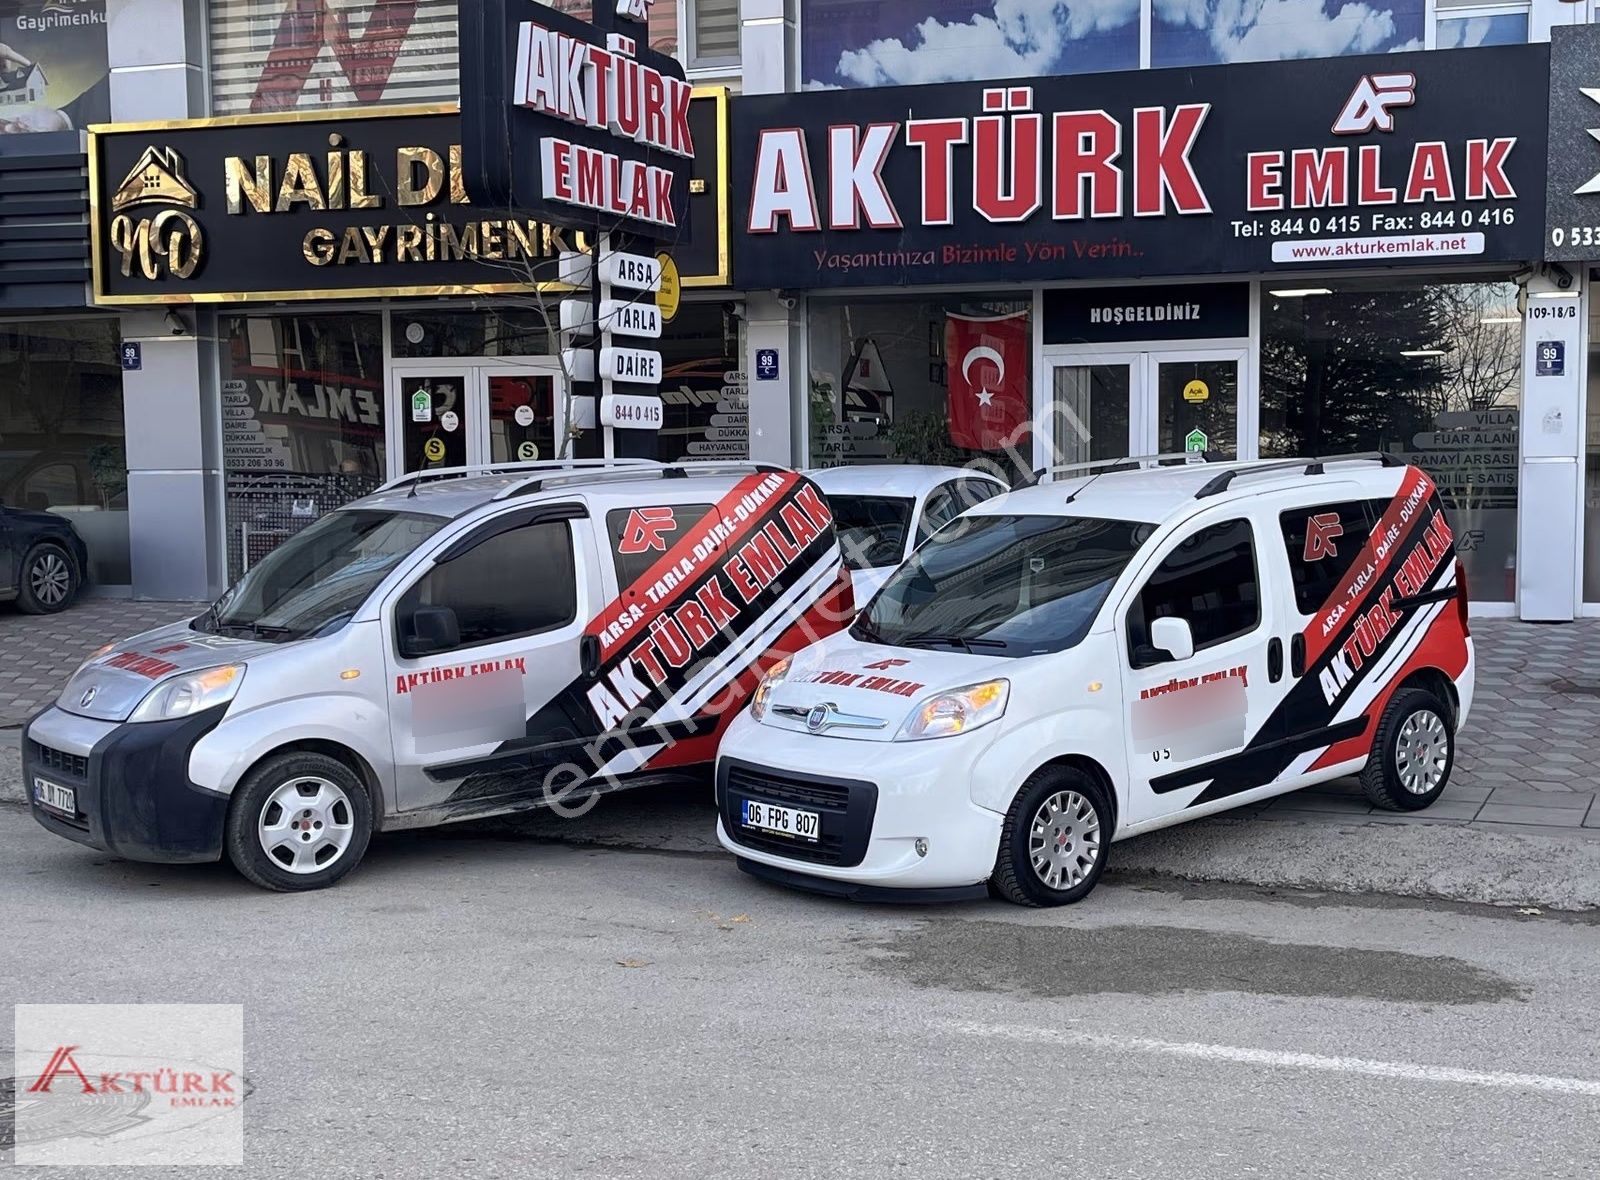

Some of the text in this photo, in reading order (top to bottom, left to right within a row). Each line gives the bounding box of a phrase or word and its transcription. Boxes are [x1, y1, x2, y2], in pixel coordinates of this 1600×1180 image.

[514, 21, 695, 159] AKTÜRK
[746, 86, 1214, 233] AKTÜRK
[224, 133, 382, 215] NAİL
[540, 136, 677, 227] EMLAK
[1246, 137, 1518, 212] EMLAK
[1231, 208, 1515, 237] Tel: 844 0 415 Fax: 844 0 416
[1291, 236, 1467, 258] www.akturkemlak.net
[1551, 227, 1565, 247] 0
[814, 248, 936, 273] Yaşantınıza
[942, 244, 1016, 265] Bizimle
[1024, 241, 1066, 263] Yön
[618, 258, 653, 284] ARSA
[617, 306, 657, 332] TARLA
[1090, 302, 1201, 325] HOŞGELDİNİZ
[617, 352, 655, 378] DAİRE
[1543, 348, 1557, 360] 99
[224, 421, 247, 430] DAİRE
[615, 405, 660, 422] 844 0 415
[1475, 413, 1515, 425] VİLLA
[225, 432, 256, 441] DÜKKAN
[820, 424, 851, 435] ARSA
[1433, 433, 1515, 445] FUAR ALANI
[820, 442, 857, 453] TARLA
[1411, 452, 1515, 466] SANAYİ ARSASI
[226, 459, 246, 467] 0533
[1454, 471, 1473, 484] İLE
[1477, 473, 1515, 486] SATIŞ
[1321, 608, 1346, 637] ARSA
[1347, 562, 1376, 601] TARLA
[1375, 526, 1401, 560] DAİRE
[1400, 476, 1429, 523] DÜKKAN
[586, 482, 834, 733] AKTÜRK EMLAK
[1318, 508, 1454, 706] AKTÜRK EMLAK
[748, 803, 762, 825] 06
[767, 807, 789, 830] FPG
[795, 813, 818, 835] 807
